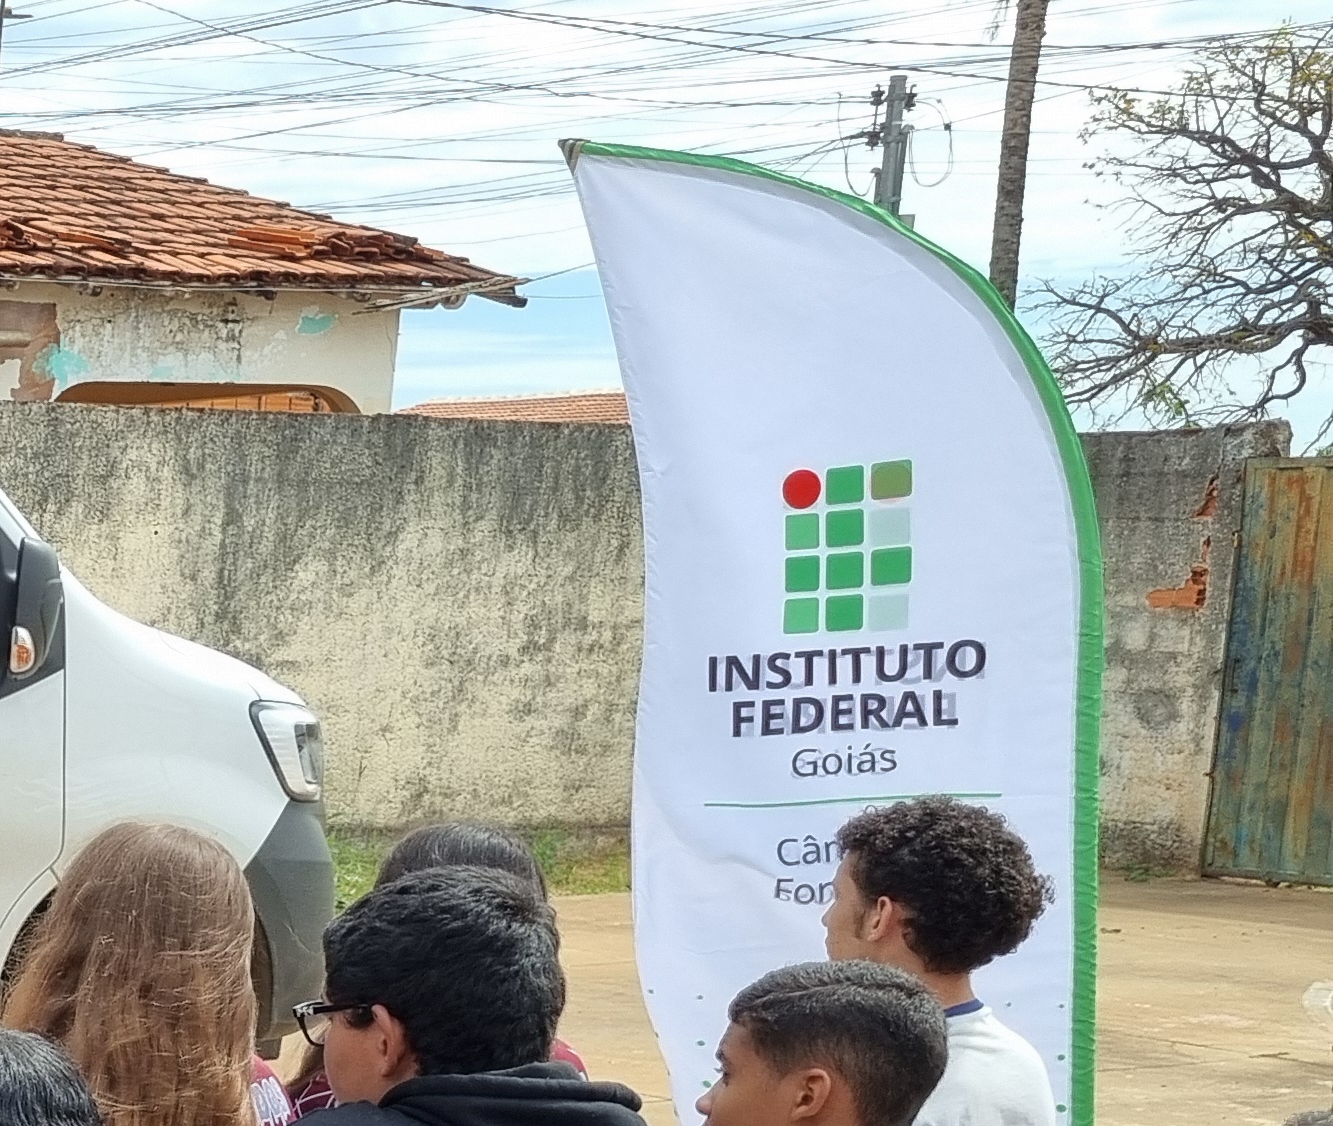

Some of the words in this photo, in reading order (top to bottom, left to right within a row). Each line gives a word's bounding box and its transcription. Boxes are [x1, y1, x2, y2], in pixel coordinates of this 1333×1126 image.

[708, 639, 987, 692] INSTITUTO
[732, 689, 959, 737] FEDERAL
[791, 743, 898, 777] Goiás
